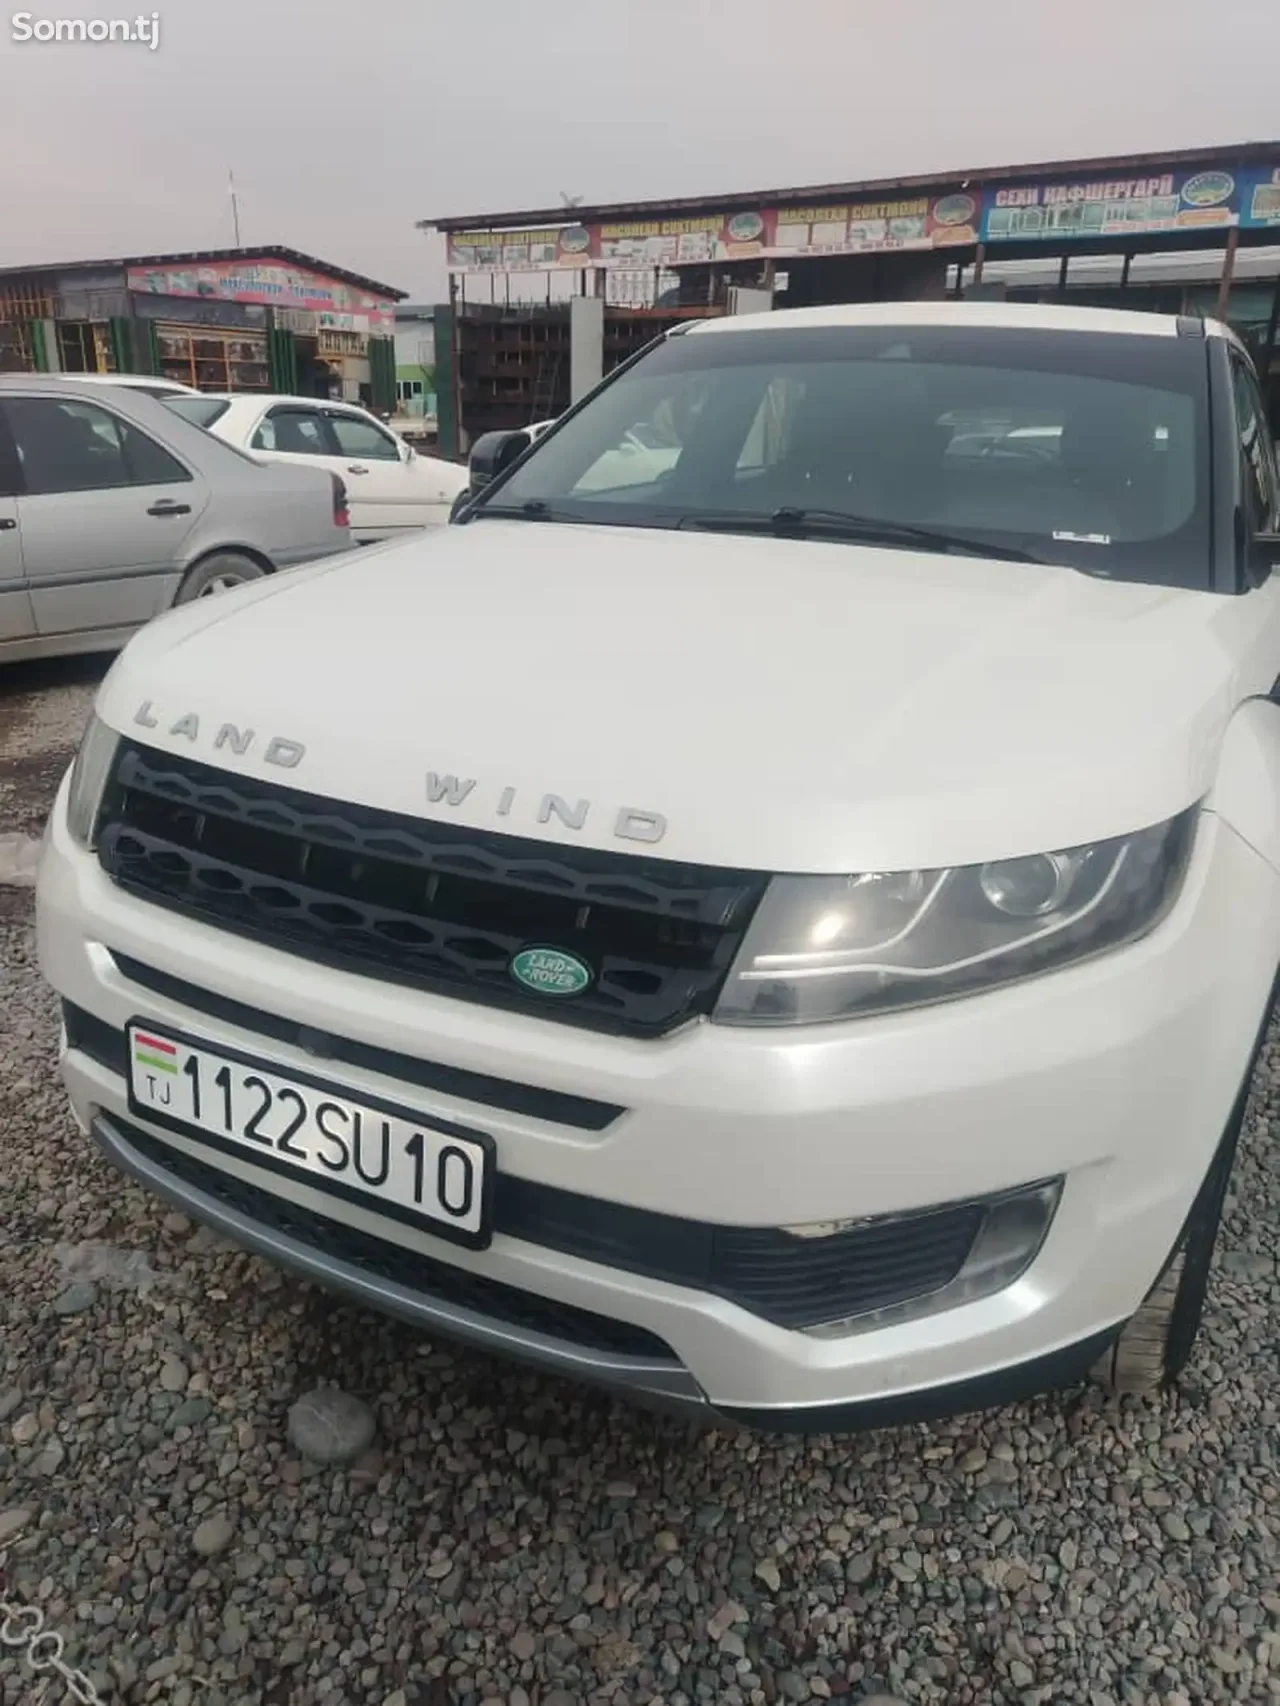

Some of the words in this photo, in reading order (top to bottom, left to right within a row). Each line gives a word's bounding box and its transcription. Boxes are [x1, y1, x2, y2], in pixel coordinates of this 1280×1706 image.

[134, 699, 307, 769] LAND
[425, 771, 668, 844] WIND
[145, 1075, 171, 1105] TJ
